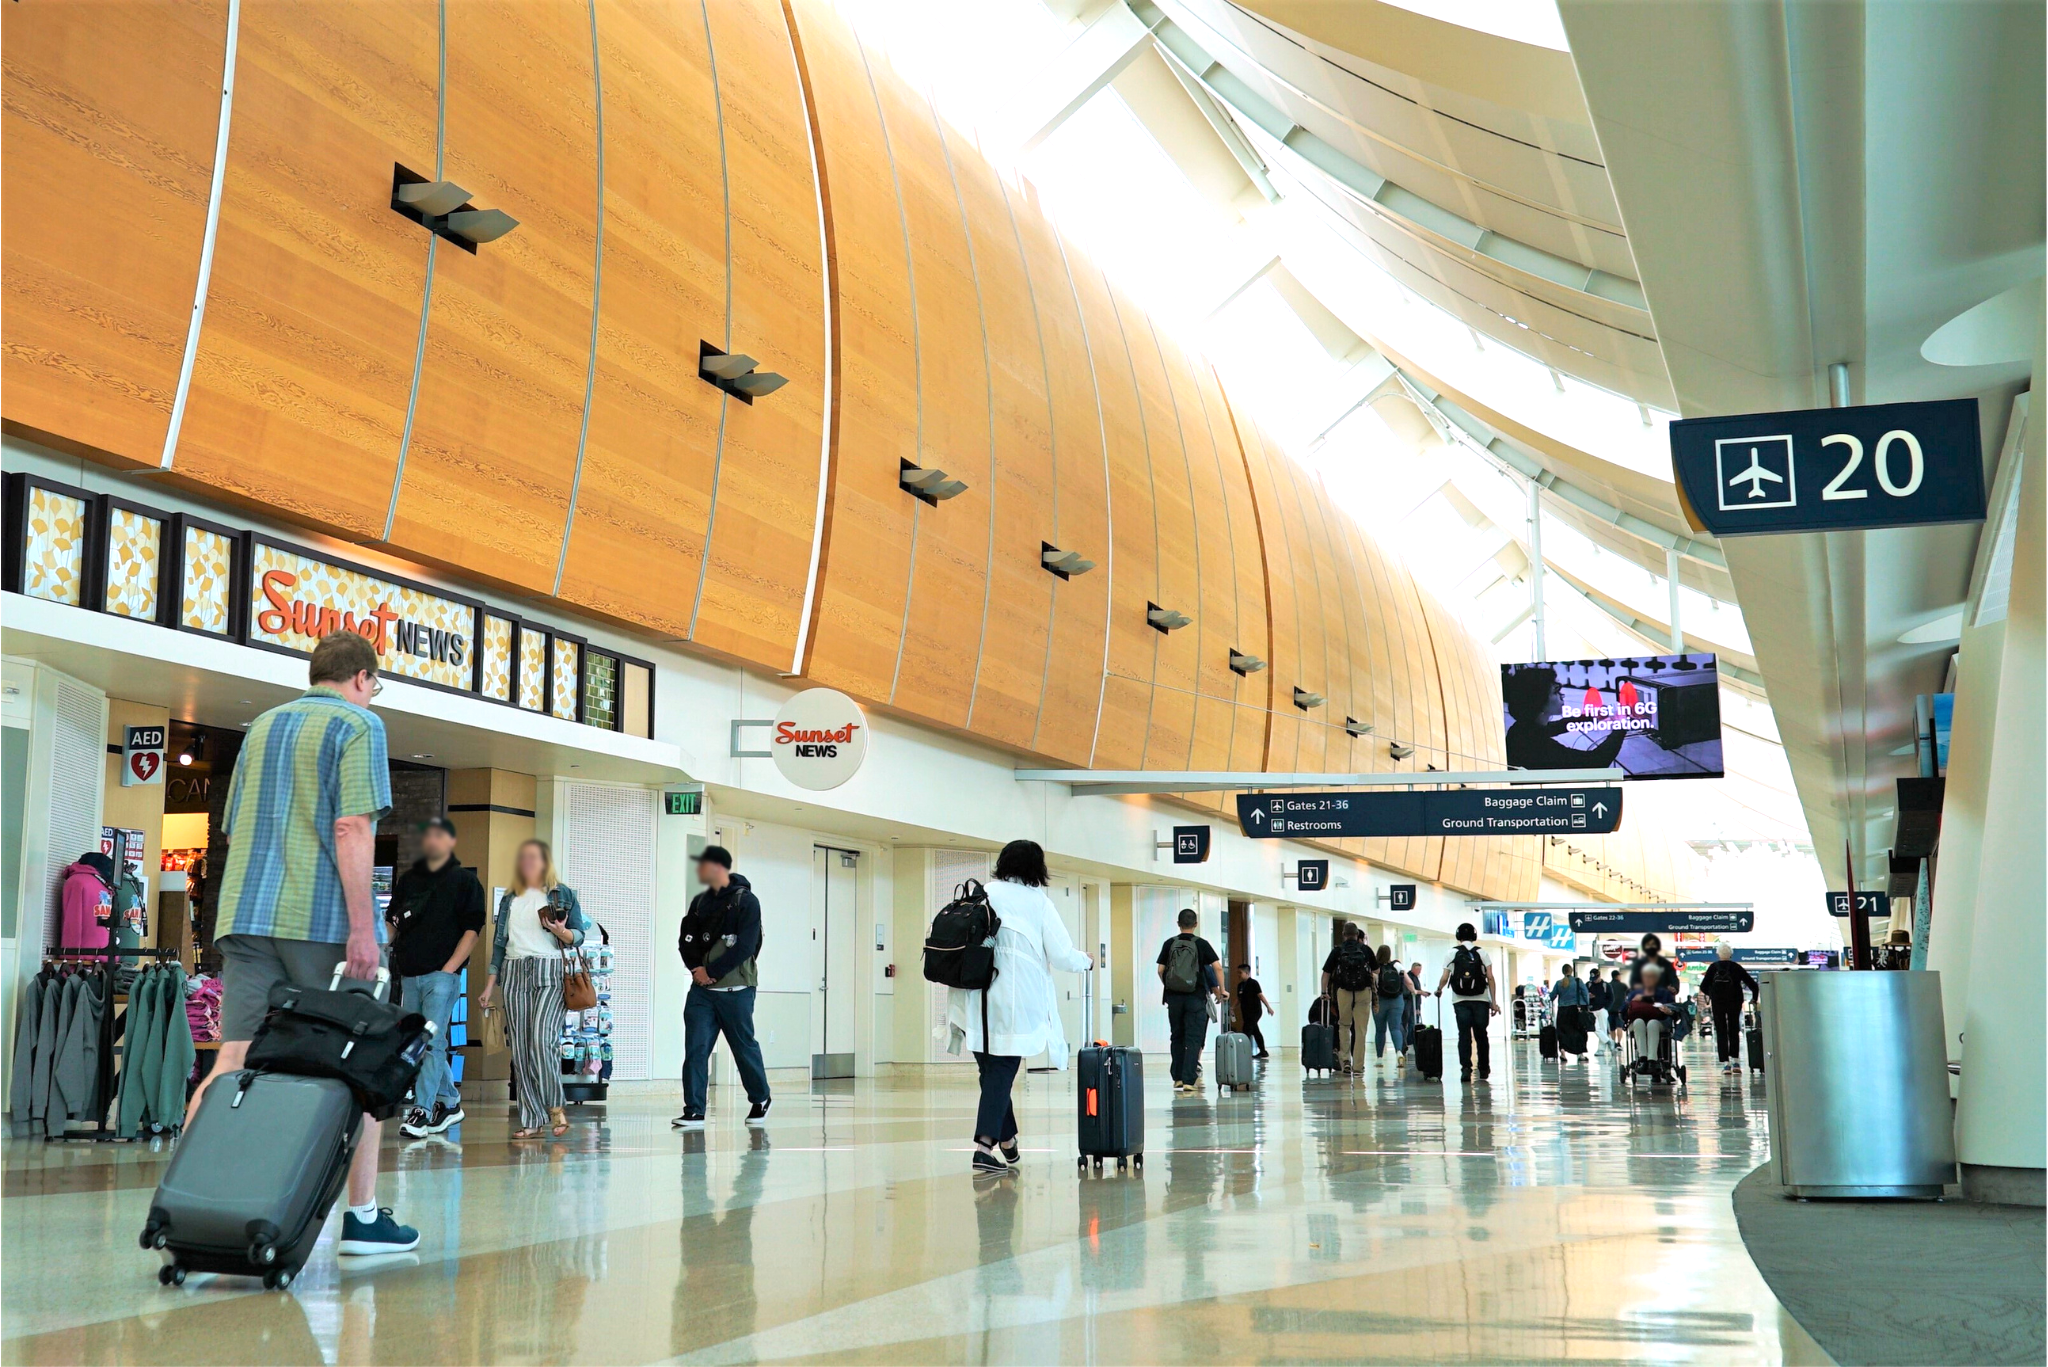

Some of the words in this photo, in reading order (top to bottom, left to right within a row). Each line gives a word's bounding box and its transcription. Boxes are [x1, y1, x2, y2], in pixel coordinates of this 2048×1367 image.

[1820, 429, 1925, 501] 20
[396, 619, 465, 666] NEWS
[1562, 705, 1581, 718] Be
[1584, 704, 1614, 716] first
[1617, 702, 1631, 715] in
[1634, 702, 1657, 714] 6G
[1566, 717, 1655, 733] exploration.
[131, 731, 162, 746] AED
[775, 722, 860, 745] Sunset
[795, 745, 838, 758] NEWS
[671, 794, 696, 814] EXIT
[1287, 801, 1317, 810] Gates
[1319, 800, 1349, 810] 21-36
[1484, 797, 1533, 809] Baggage
[1536, 796, 1568, 806] Claim
[1287, 821, 1342, 831] Restrooms
[1442, 818, 1484, 828] Ground
[1486, 816, 1569, 829] Transportation
[1690, 923, 1729, 931] Transportation
